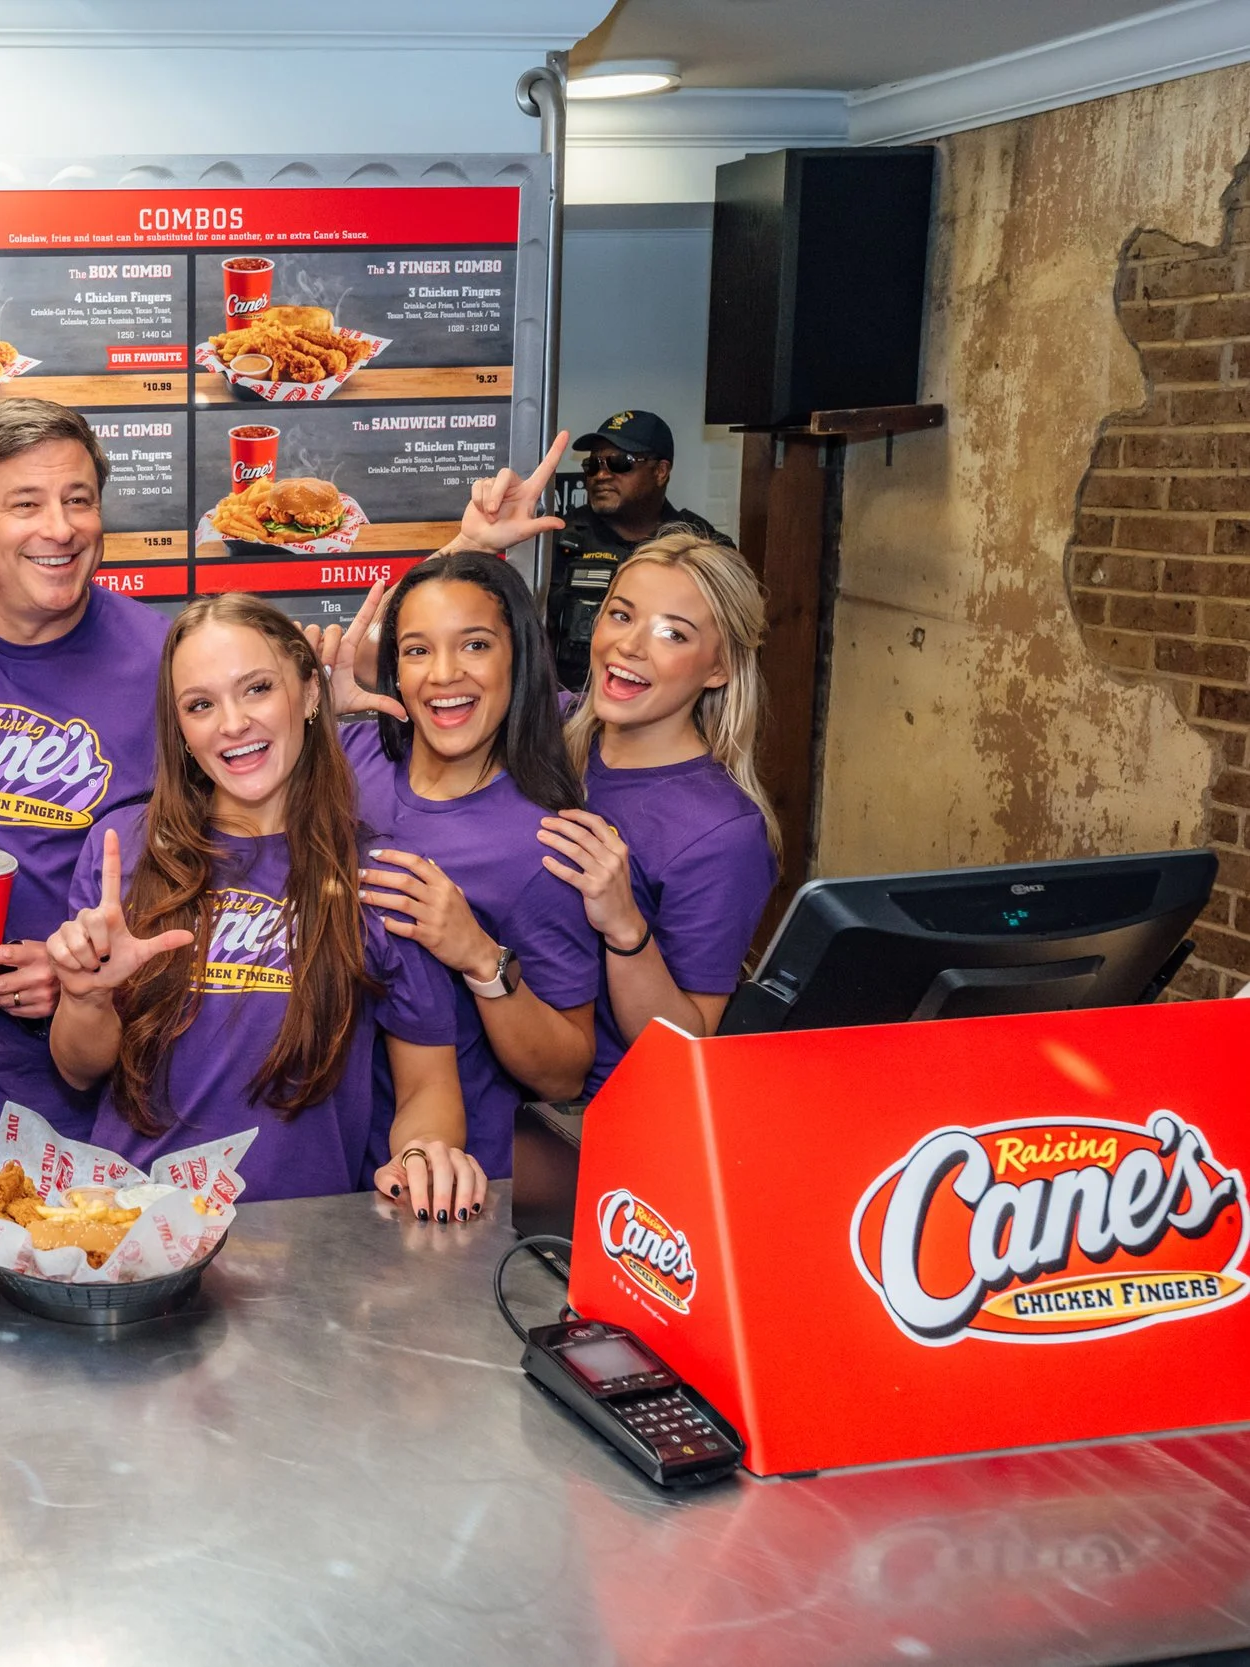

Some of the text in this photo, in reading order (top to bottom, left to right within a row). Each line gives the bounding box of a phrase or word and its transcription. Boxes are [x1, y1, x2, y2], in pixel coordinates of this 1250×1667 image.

[139, 207, 243, 231] COMBOS
[8, 233, 48, 244] Coleslaw,
[51, 233, 71, 243] fries
[73, 233, 90, 242] and
[92, 233, 114, 242] toast
[116, 234, 131, 242] can
[133, 232, 144, 241] be
[146, 232, 193, 241] substituted
[195, 232, 208, 241] for
[210, 233, 226, 241] one
[228, 232, 263, 242] another,
[276, 232, 287, 240] an
[289, 231, 311, 240] extra
[313, 230, 340, 240] Cane's
[341, 230, 369, 239] Sauce.
[68, 264, 172, 280] The BOX COMBO
[367, 260, 502, 275] The 3 FINGER COMBO
[74, 291, 172, 305] 4 Chicken Fingers
[408, 286, 501, 298] 3 Chicken Fingers
[31, 308, 67, 316] Crinkle-Cut
[67, 308, 85, 317] Fries,
[92, 307, 112, 315] Cane's
[113, 307, 133, 316] Sauce,
[135, 307, 153, 315] Texas
[154, 306, 172, 315] Toast,
[226, 293, 269, 317] Cane's
[403, 302, 437, 310] Crinkle-Cut
[438, 302, 454, 310] Fries,
[481, 301, 500, 309] Sauce,
[60, 318, 89, 326] Coleslaw,
[107, 317, 135, 325] Fountain
[136, 316, 154, 324] Drink
[162, 316, 172, 324] Tea
[405, 312, 423, 320] Toast,
[117, 330, 172, 339] 1250 1440 Cal
[447, 324, 500, 332] 1020 1210 Cal
[111, 352, 182, 363] OUR FAVORITE
[475, 374, 498, 384] $9.23
[143, 382, 172, 391] $10.99
[352, 415, 497, 431] The SANDWICH COMBO
[91, 423, 172, 438] IAC COMBO
[404, 440, 496, 453] 3 Chicken Fingers
[131, 450, 172, 462] Fingers
[232, 460, 274, 483] Cane's
[368, 466, 401, 474] Crinkle-Cut
[402, 466, 418, 474] Fries,
[435, 465, 461, 473] Fountain
[462, 464, 478, 472] Drink
[443, 478, 460, 486] 1080
[118, 486, 172, 496] 1790 2040 Cal
[144, 537, 172, 546] $15.99
[582, 552, 619, 561] MITCHELL
[321, 565, 391, 583] DRINKS
[92, 574, 145, 592] TRAS
[321, 600, 342, 613] Tea
[14, 799, 74, 822] FINGERS
[236, 968, 292, 986] FINGERS
[44, 1142, 56, 1172] ONE
[995, 1131, 1118, 1175] Raising
[634, 1204, 668, 1239] Raising
[880, 1116, 1238, 1339] Cane's
[602, 1190, 695, 1285] Cane's
[628, 1258, 654, 1284] CHICKEN
[1014, 1276, 1220, 1317] CHICKEN FINGERS
